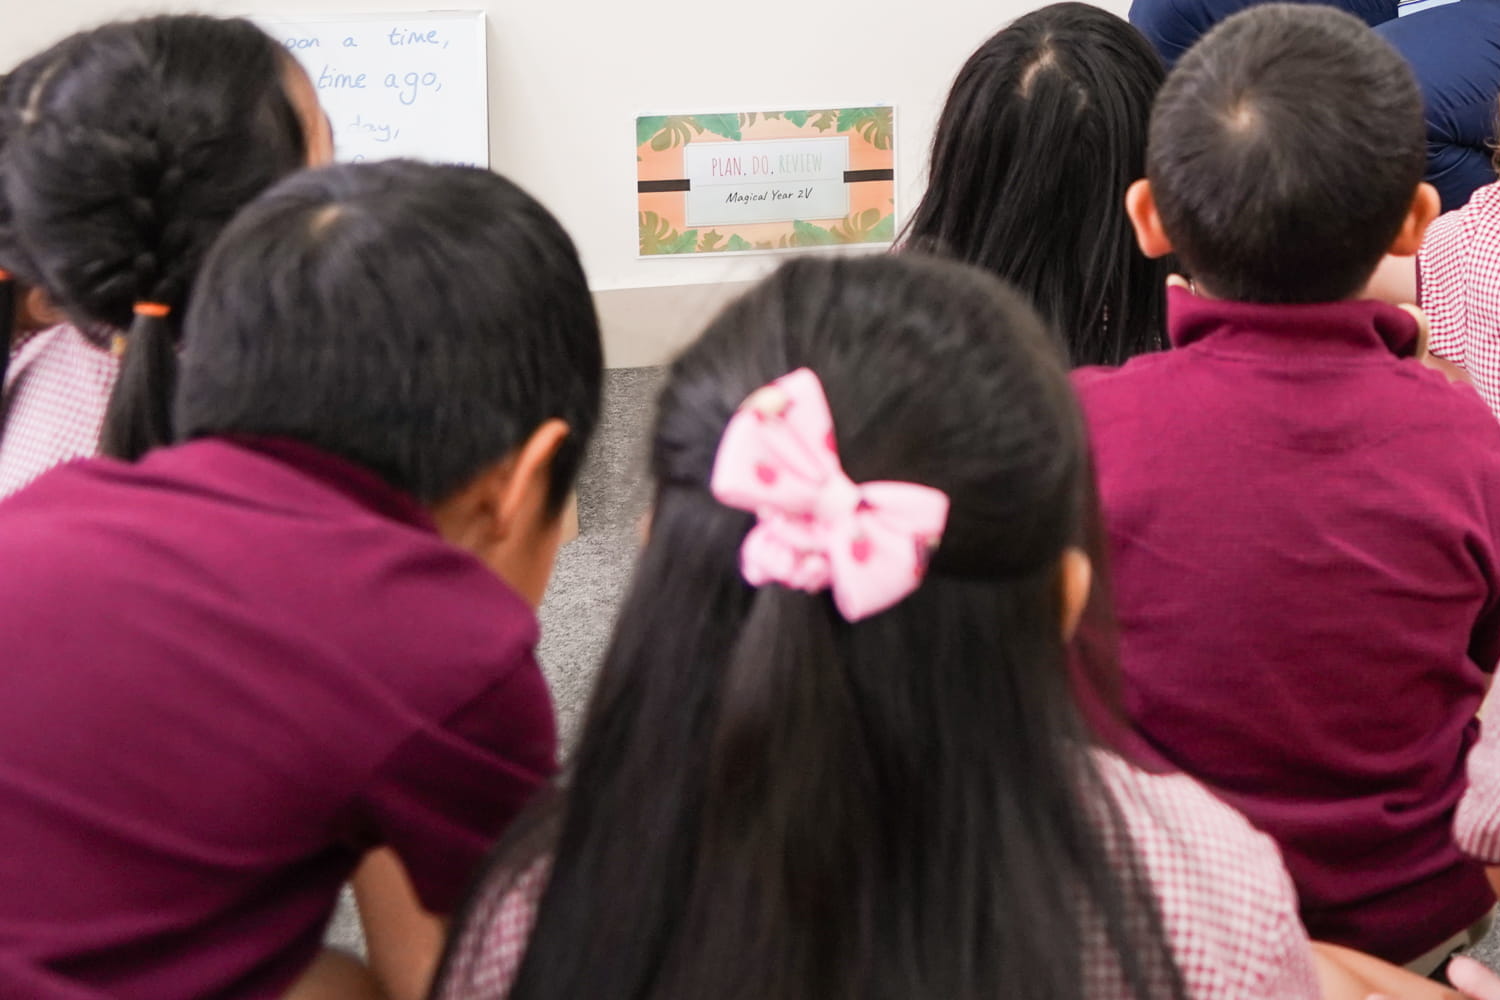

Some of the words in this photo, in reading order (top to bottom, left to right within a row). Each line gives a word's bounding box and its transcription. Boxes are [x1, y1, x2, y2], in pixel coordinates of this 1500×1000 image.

[342, 36, 358, 48] a
[388, 27, 449, 49] time,
[317, 64, 367, 89] time
[778, 153, 822, 174] REVIEW
[725, 190, 768, 206] Magical
[772, 189, 794, 202] Year
[797, 187, 814, 200] 2V
